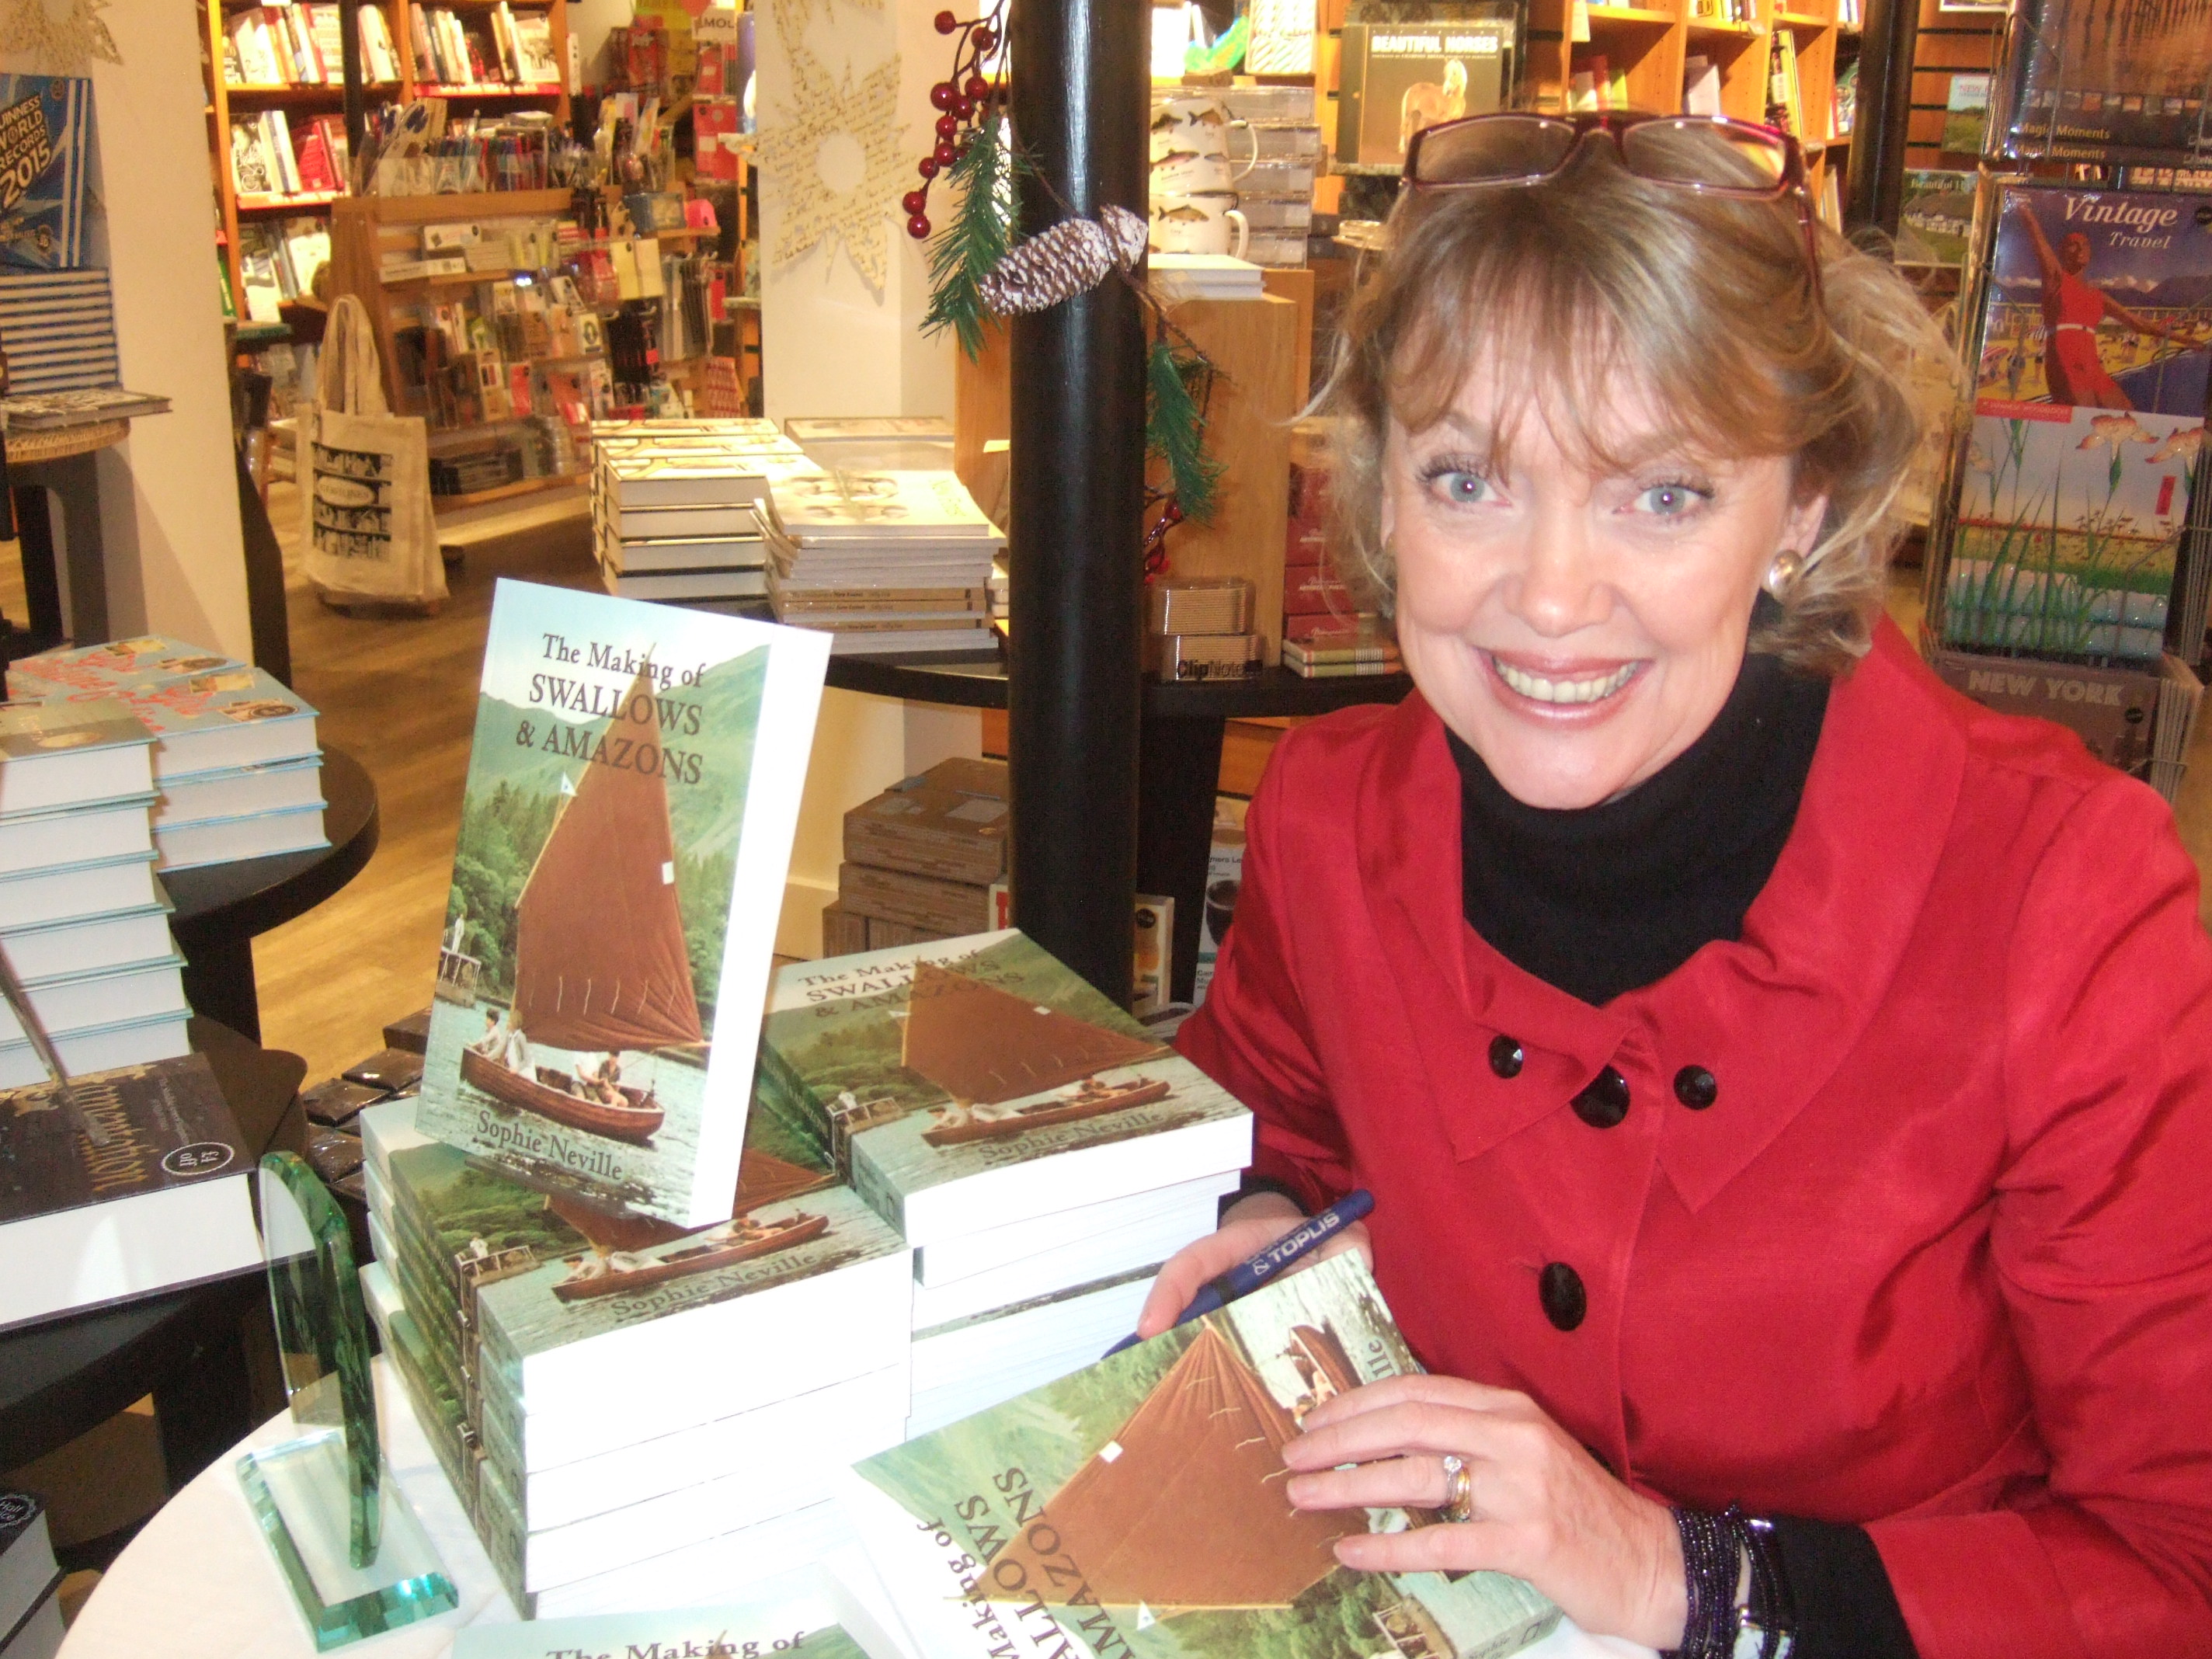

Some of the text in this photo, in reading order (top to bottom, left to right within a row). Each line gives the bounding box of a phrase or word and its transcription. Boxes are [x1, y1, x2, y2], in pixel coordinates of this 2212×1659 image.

[1371, 36, 1498, 53] BEAUTIFUL HORSES
[2056, 124, 2110, 139] Moments
[2051, 146, 2106, 160] Moments
[0, 137, 50, 209] 2015
[2065, 197, 2178, 234] Vintage
[2109, 232, 2172, 249] Travel
[543, 633, 707, 691] The Making of
[530, 673, 703, 736] SWALLOWS
[1969, 671, 2125, 706] NEW YORK
[516, 720, 703, 784] & AMAZONS
[798, 948, 980, 987] The Making of
[816, 1005, 840, 1018] &
[477, 1111, 622, 1181] Sophie Neville
[979, 1111, 1165, 1160] Sophie Neville
[179, 1153, 198, 1167] off
[201, 1151, 219, 1163] £4
[1253, 1259, 1271, 1275] &
[1268, 1213, 1340, 1262] TOPLIS
[611, 1252, 817, 1315] Sophie Neville
[916, 1518, 952, 1547] of
[626, 1640, 760, 1659] Making
[773, 1631, 805, 1650] of
